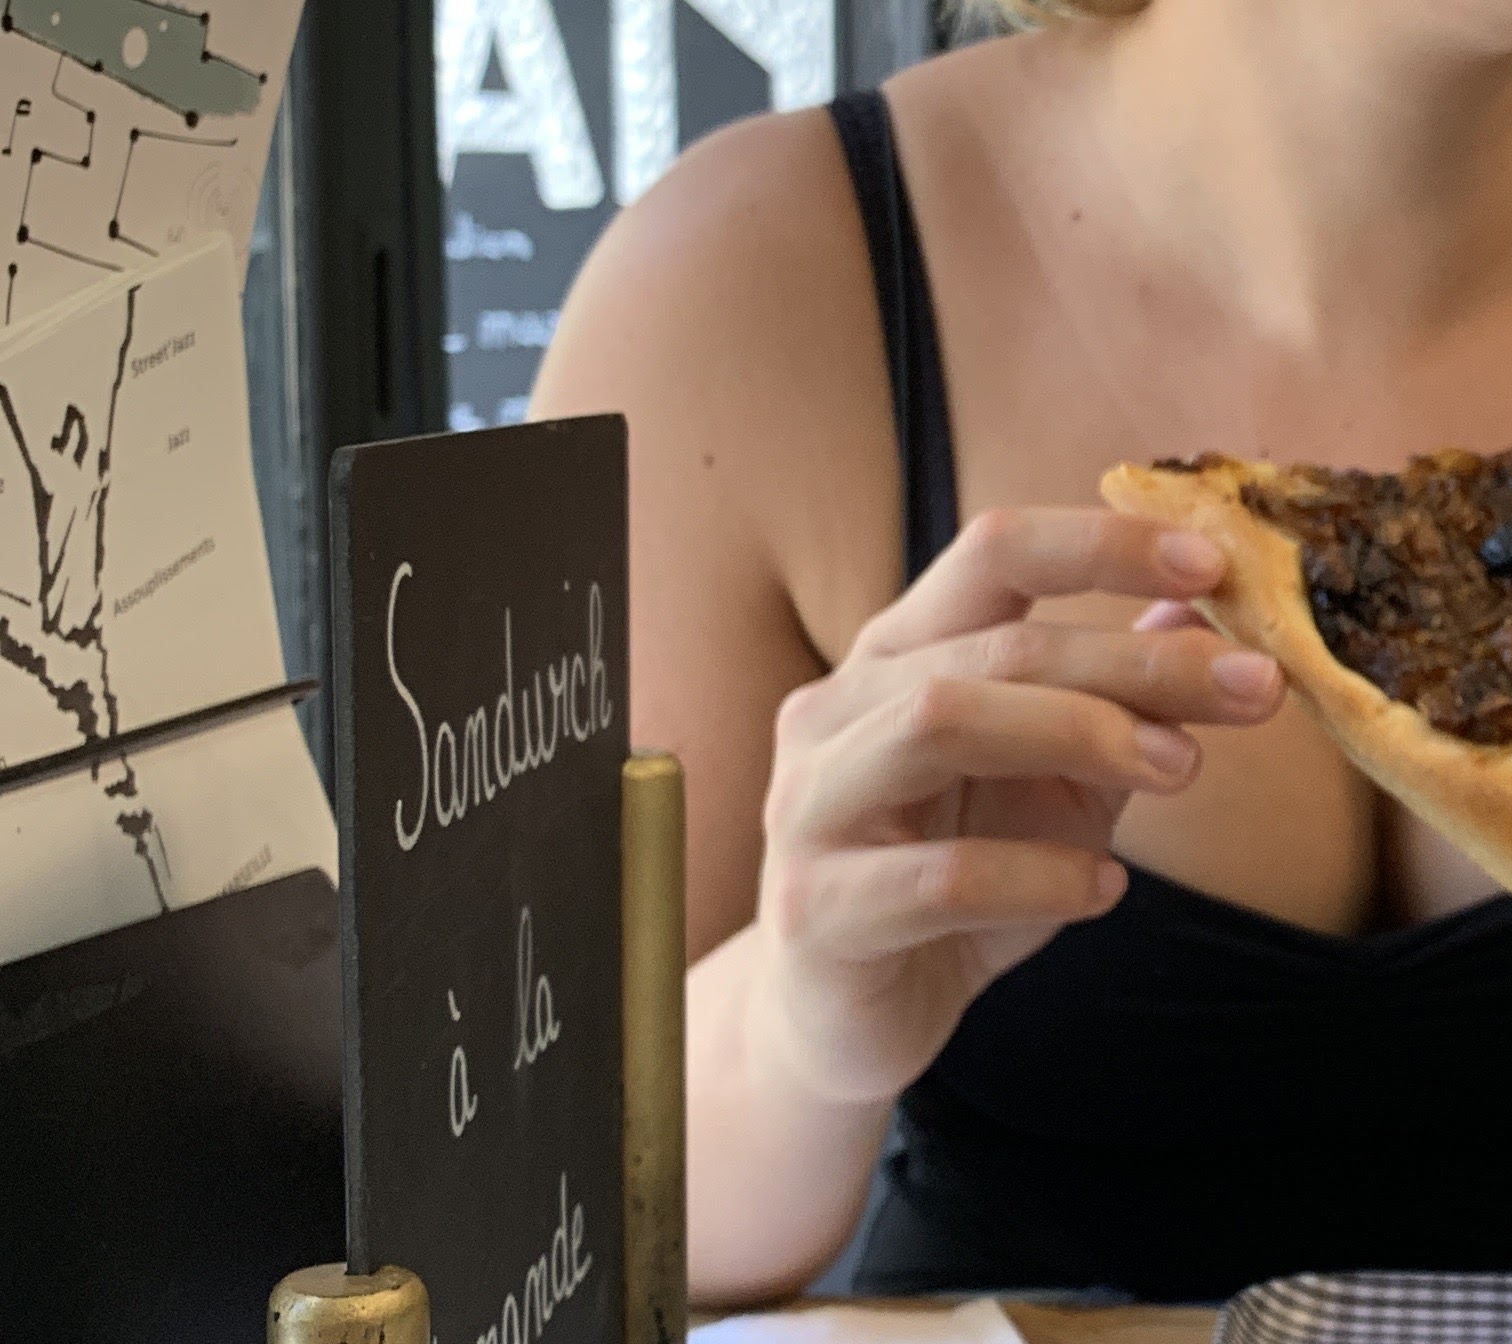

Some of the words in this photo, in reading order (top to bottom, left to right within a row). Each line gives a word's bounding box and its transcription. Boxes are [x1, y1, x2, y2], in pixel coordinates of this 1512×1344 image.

[388, 561, 612, 851] Sandwich
[449, 988, 478, 1137] à
[514, 906, 562, 1070] la
